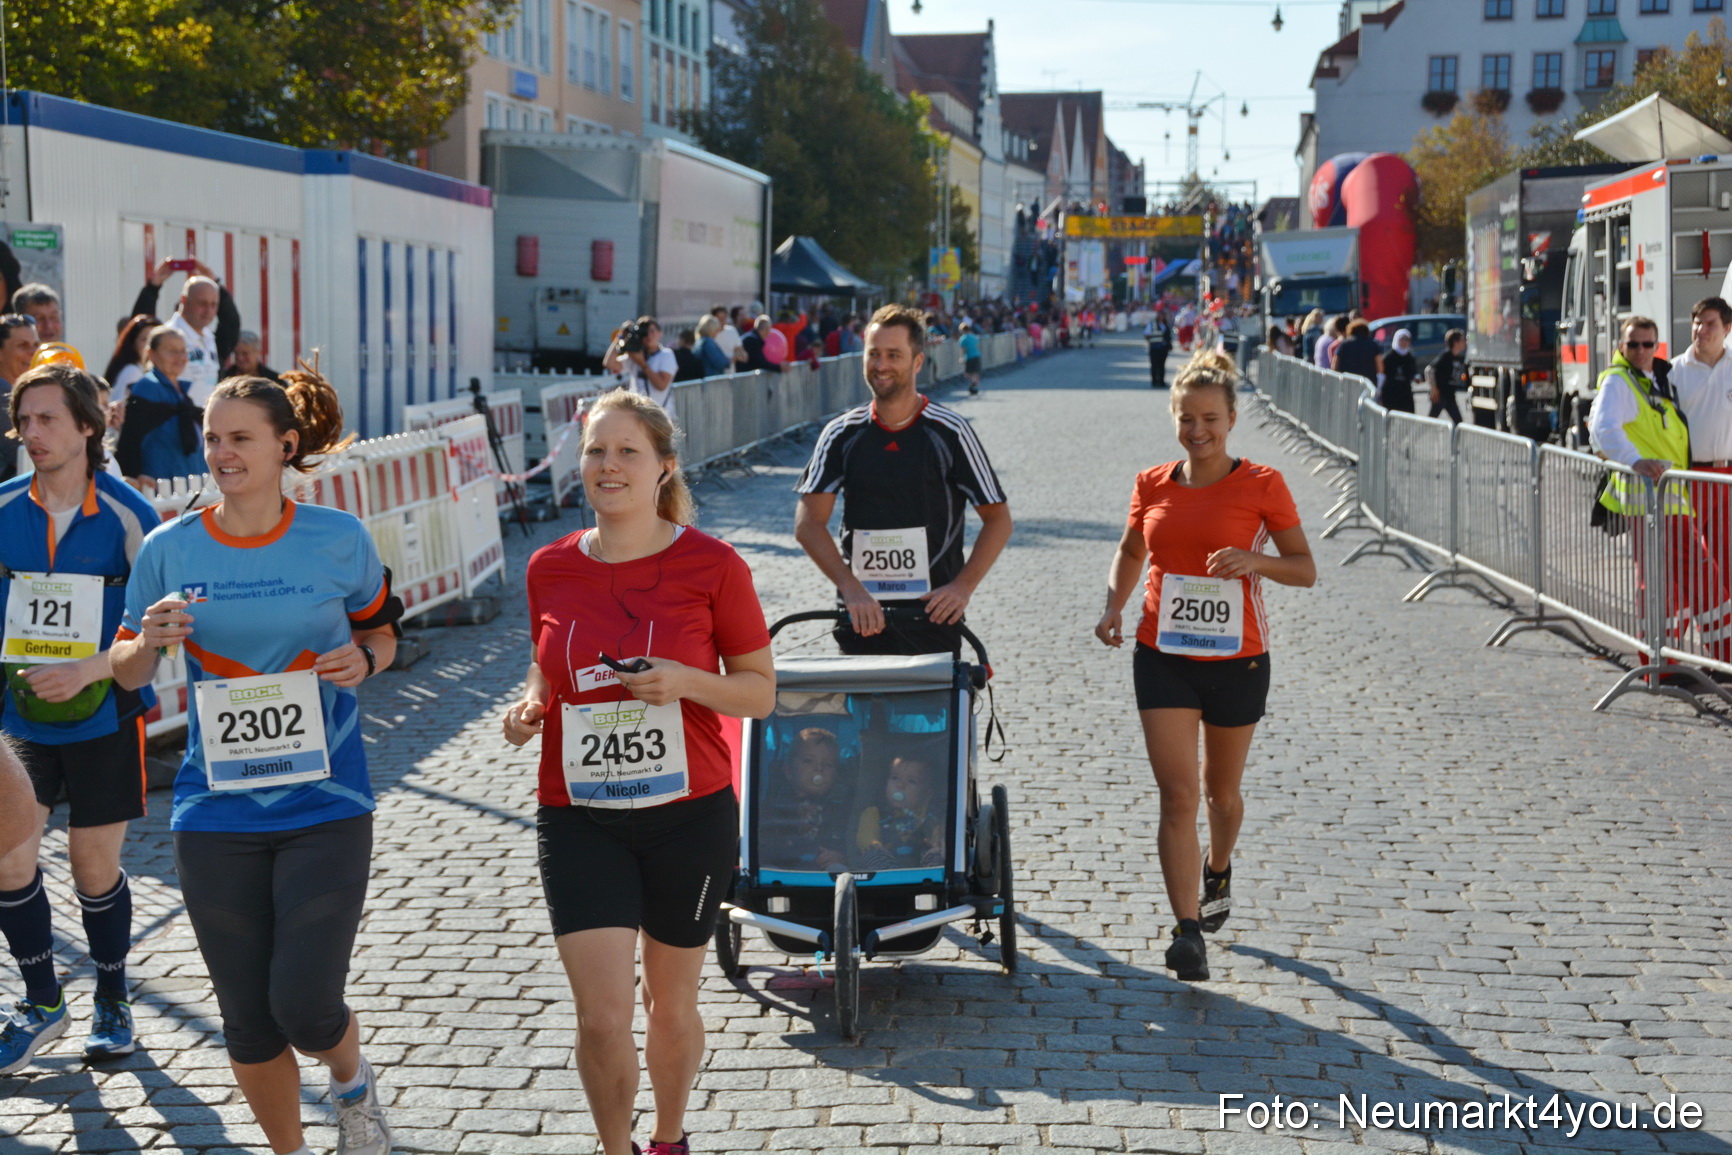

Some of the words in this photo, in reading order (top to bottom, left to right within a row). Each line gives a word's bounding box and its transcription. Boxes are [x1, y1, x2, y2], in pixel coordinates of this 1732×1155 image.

[862, 549, 916, 570] 2508
[32, 581, 73, 593] BOCK
[213, 577, 284, 590] Raiffeisenbank
[878, 582, 906, 591] Marco
[1184, 582, 1220, 593] BOCK
[213, 589, 261, 601] Neumarkt
[300, 585, 314, 594] eG
[28, 598, 72, 627] 121
[1171, 597, 1230, 624] 2509
[1181, 634, 1216, 647] Sandra
[25, 641, 72, 656] Gerhard
[594, 669, 616, 682] DEH
[229, 684, 284, 701] BOCK
[217, 703, 305, 743] 2302
[593, 709, 646, 725] BOCK
[229, 747, 253, 755] PARTL
[254, 744, 290, 753] Neumarkt
[581, 729, 667, 766] 2453
[241, 758, 293, 776] Jasmin
[617, 767, 652, 777] Neumarkt
[606, 782, 650, 797] Nicole
